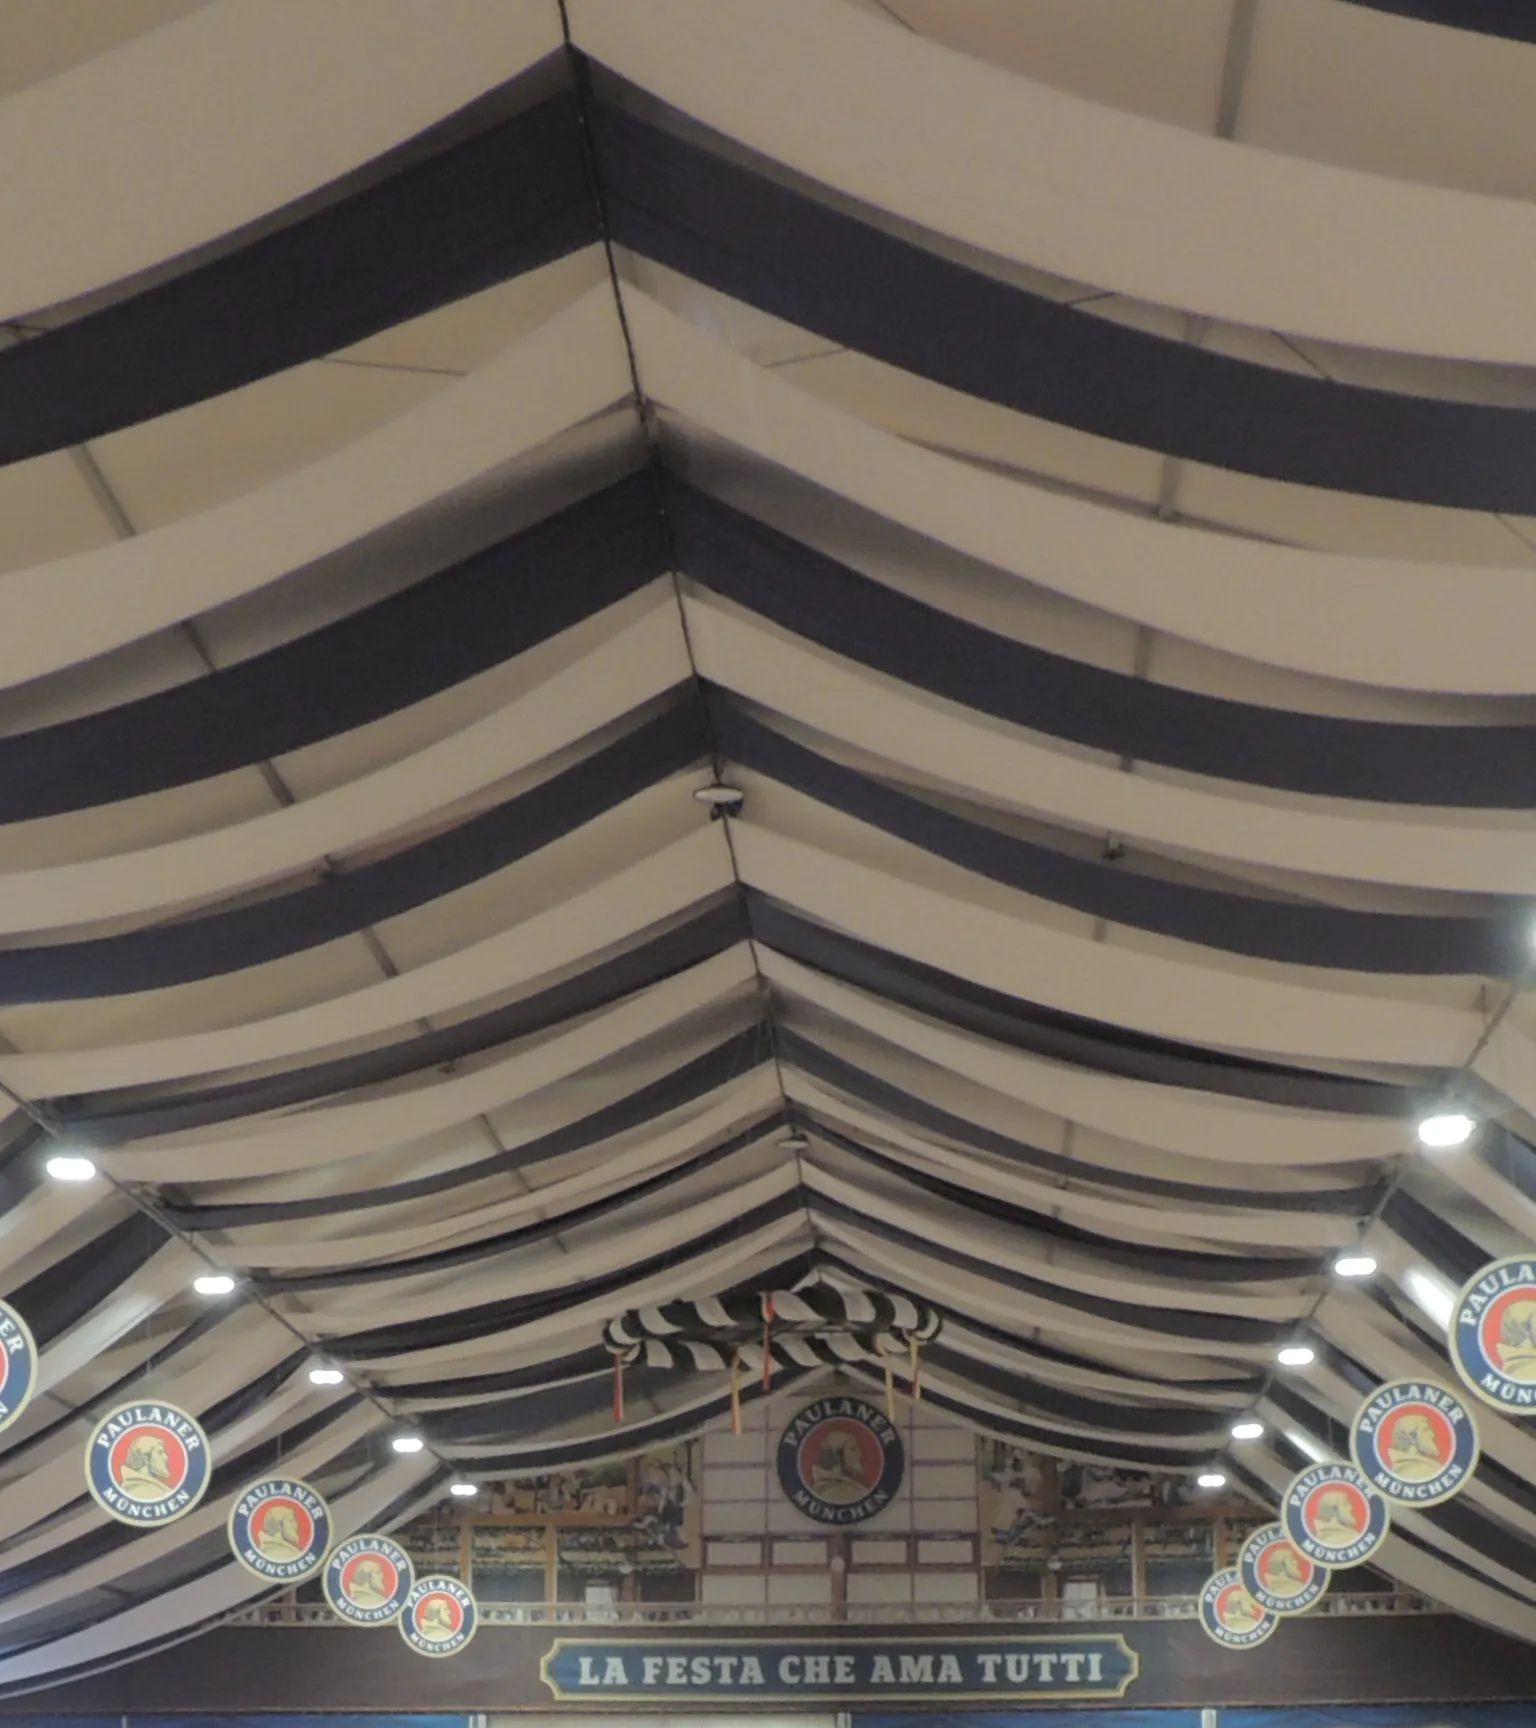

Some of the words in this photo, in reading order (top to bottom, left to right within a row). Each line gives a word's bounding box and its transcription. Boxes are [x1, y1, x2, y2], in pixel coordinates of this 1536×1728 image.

[783, 1400, 896, 1447] PAULANER
[1359, 1385, 1465, 1434] PAULANER
[97, 1406, 201, 1451] PAULANER
[1374, 1464, 1463, 1499] MÜNCHEN
[102, 1489, 191, 1519] MÜNCHEN
[237, 1482, 324, 1520] PAULANER
[243, 1549, 317, 1577] MÜNCHEN
[332, 1538, 407, 1572] PAULANER
[1301, 1532, 1376, 1561] MÜNCHEN
[336, 1598, 400, 1621] MÜNCHEN
[578, 1657, 629, 1686] LA
[642, 1656, 765, 1686] FESTA
[779, 1655, 855, 1684] CHE
[870, 1655, 963, 1683] AMA
[977, 1653, 1103, 1683] TUTTI
